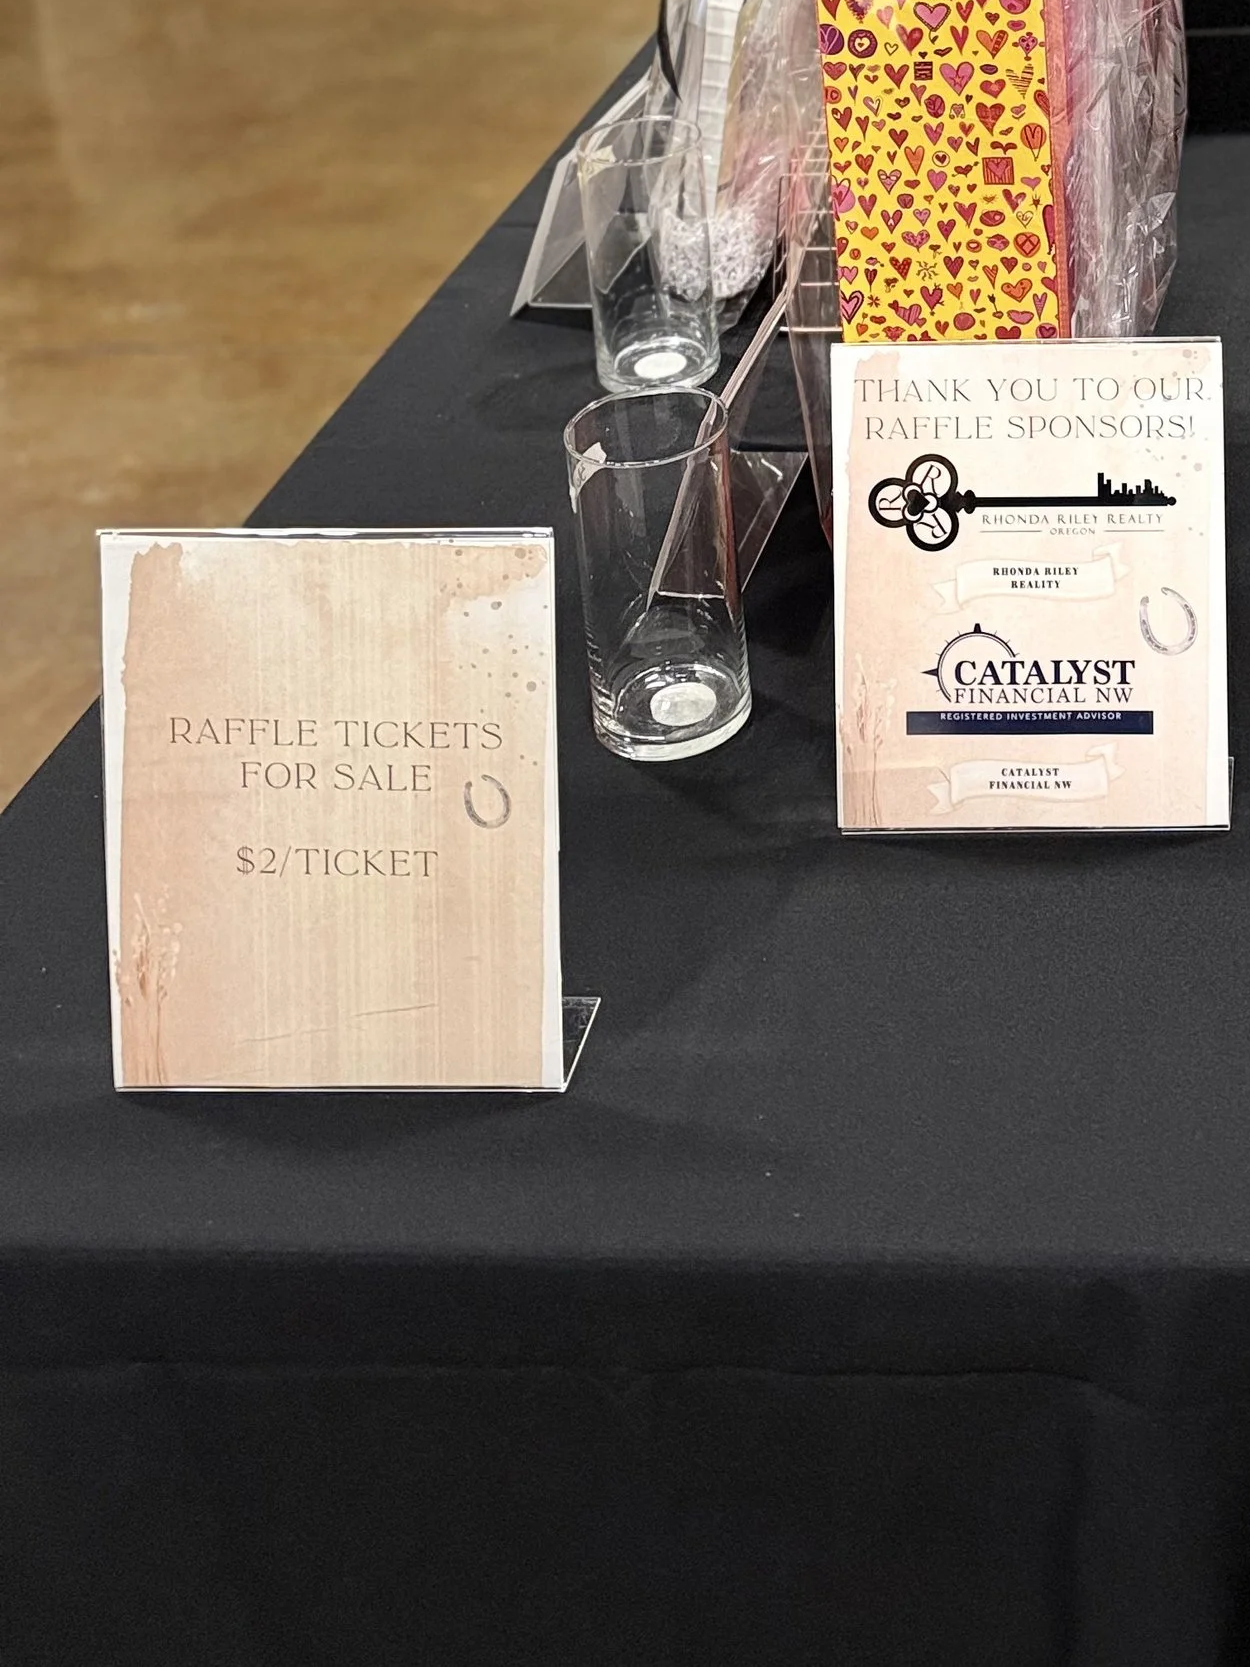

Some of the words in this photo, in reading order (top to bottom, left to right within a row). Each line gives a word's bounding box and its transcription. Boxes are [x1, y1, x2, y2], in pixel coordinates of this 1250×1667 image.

[854, 378, 971, 403] THANK
[987, 378, 1057, 403] YOU
[1073, 377, 1120, 402] TO
[1133, 377, 1205, 401] OUR
[865, 415, 993, 440] RAFFLE
[1007, 415, 1195, 440] SPONSORS!
[982, 514, 1050, 525] RHONDA
[1057, 514, 1098, 525] RILEY
[1107, 514, 1163, 524] REALTY
[993, 567, 1040, 576] RHONDA
[1044, 567, 1079, 576] RILEY
[1011, 580, 1061, 590] REALITY
[954, 660, 1136, 685] CATALYST
[954, 687, 1086, 704] FINANCIAL
[1096, 687, 1134, 703] NW
[940, 712, 1003, 721] REGISTERED
[1006, 712, 1072, 721] INVESTMENT
[1077, 712, 1122, 720] ADVISOR
[169, 716, 318, 748] RAFFLE
[335, 720, 503, 750] TICKETS
[240, 761, 318, 790] FOR
[333, 763, 433, 793] SALE
[1001, 768, 1059, 776] CATALYST
[989, 781, 1050, 790] FINANCIAL
[1054, 781, 1072, 790] NW
[235, 845, 439, 878] $2/TICKET
